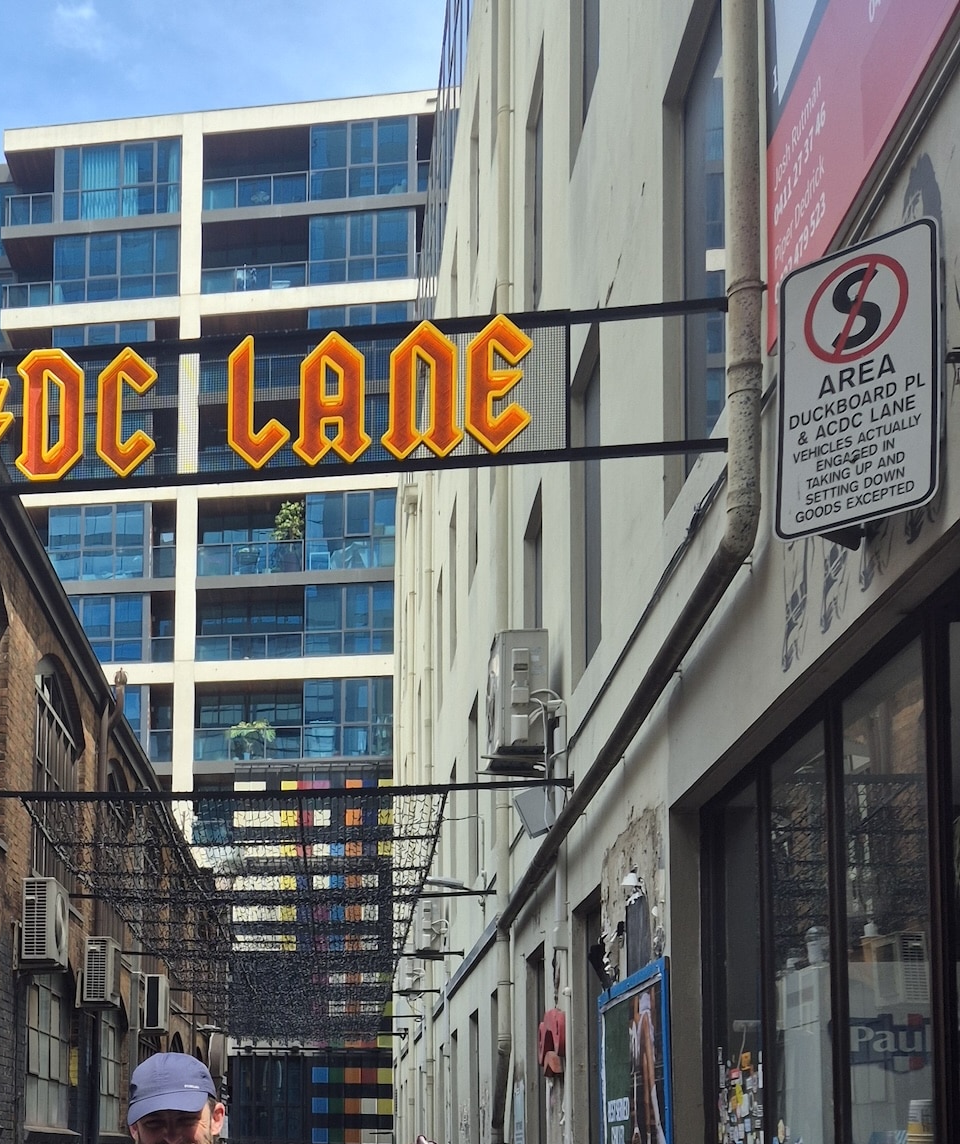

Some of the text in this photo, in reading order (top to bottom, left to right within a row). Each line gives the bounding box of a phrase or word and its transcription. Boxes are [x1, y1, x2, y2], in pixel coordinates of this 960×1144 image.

[774, 75, 821, 192] Josh Rutman
[774, 101, 826, 226] 0411 27 37 46
[774, 219, 794, 270] Piper
[794, 154, 825, 229] Dedrick
[793, 191, 826, 266] 479 523
[227, 313, 534, 470] LANE
[789, 372, 926, 431] DUCKBOARD PL
[818, 353, 896, 399] AREA
[792, 413, 922, 464] VEHICLES ACTUALLY
[797, 394, 916, 447] & ACDC LANE
[806, 451, 906, 490] TAKING UP AND
[816, 438, 896, 473] ENGAGED IN
[795, 480, 915, 524] GOODS EXCEPTED
[805, 466, 906, 506] SETTING DOWN
